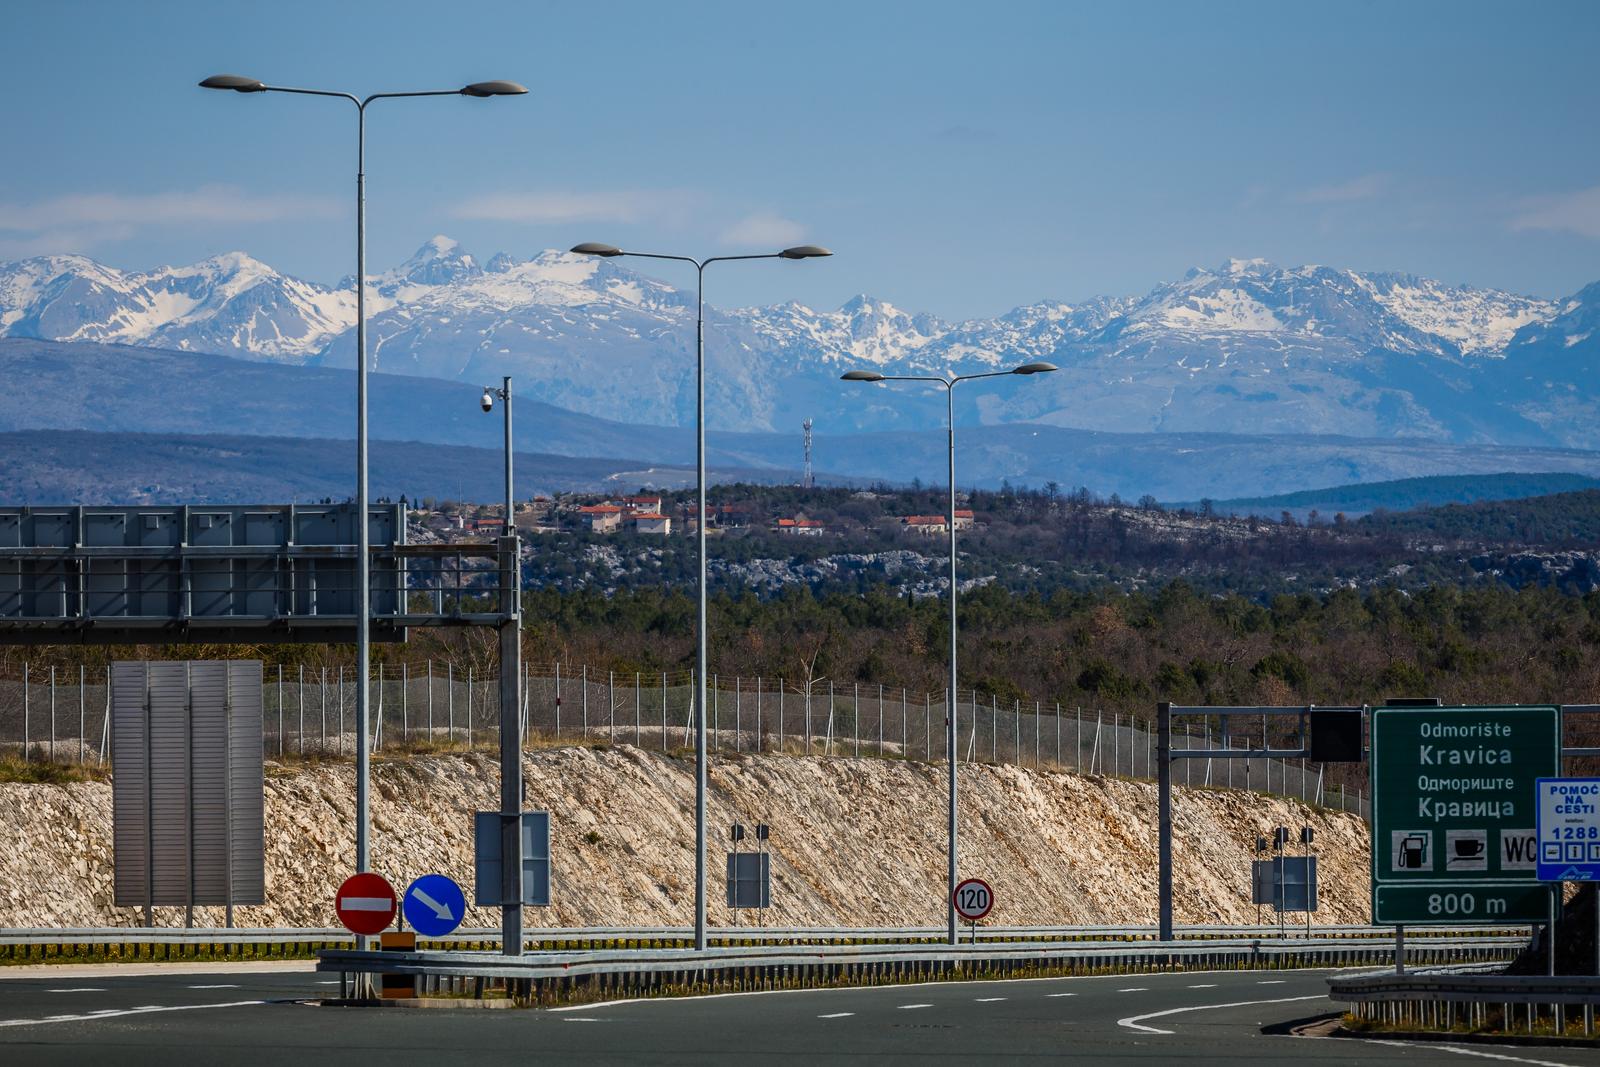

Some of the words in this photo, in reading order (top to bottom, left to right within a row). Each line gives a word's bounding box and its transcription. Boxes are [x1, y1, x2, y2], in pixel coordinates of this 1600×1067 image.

[1420, 722, 1512, 737] Odmorište
[1420, 745, 1512, 765] Kravica
[1418, 775, 1514, 793] Одмориште
[1550, 784, 1599, 795] POMOĆ
[1565, 795, 1583, 804] NA
[1418, 797, 1514, 822] Кравица
[1555, 805, 1594, 814] CESTI
[1552, 827, 1598, 840] 1288
[1504, 836, 1536, 862] WC
[960, 889, 987, 909] 120
[1428, 893, 1475, 914] 800
[1485, 897, 1507, 914] m
